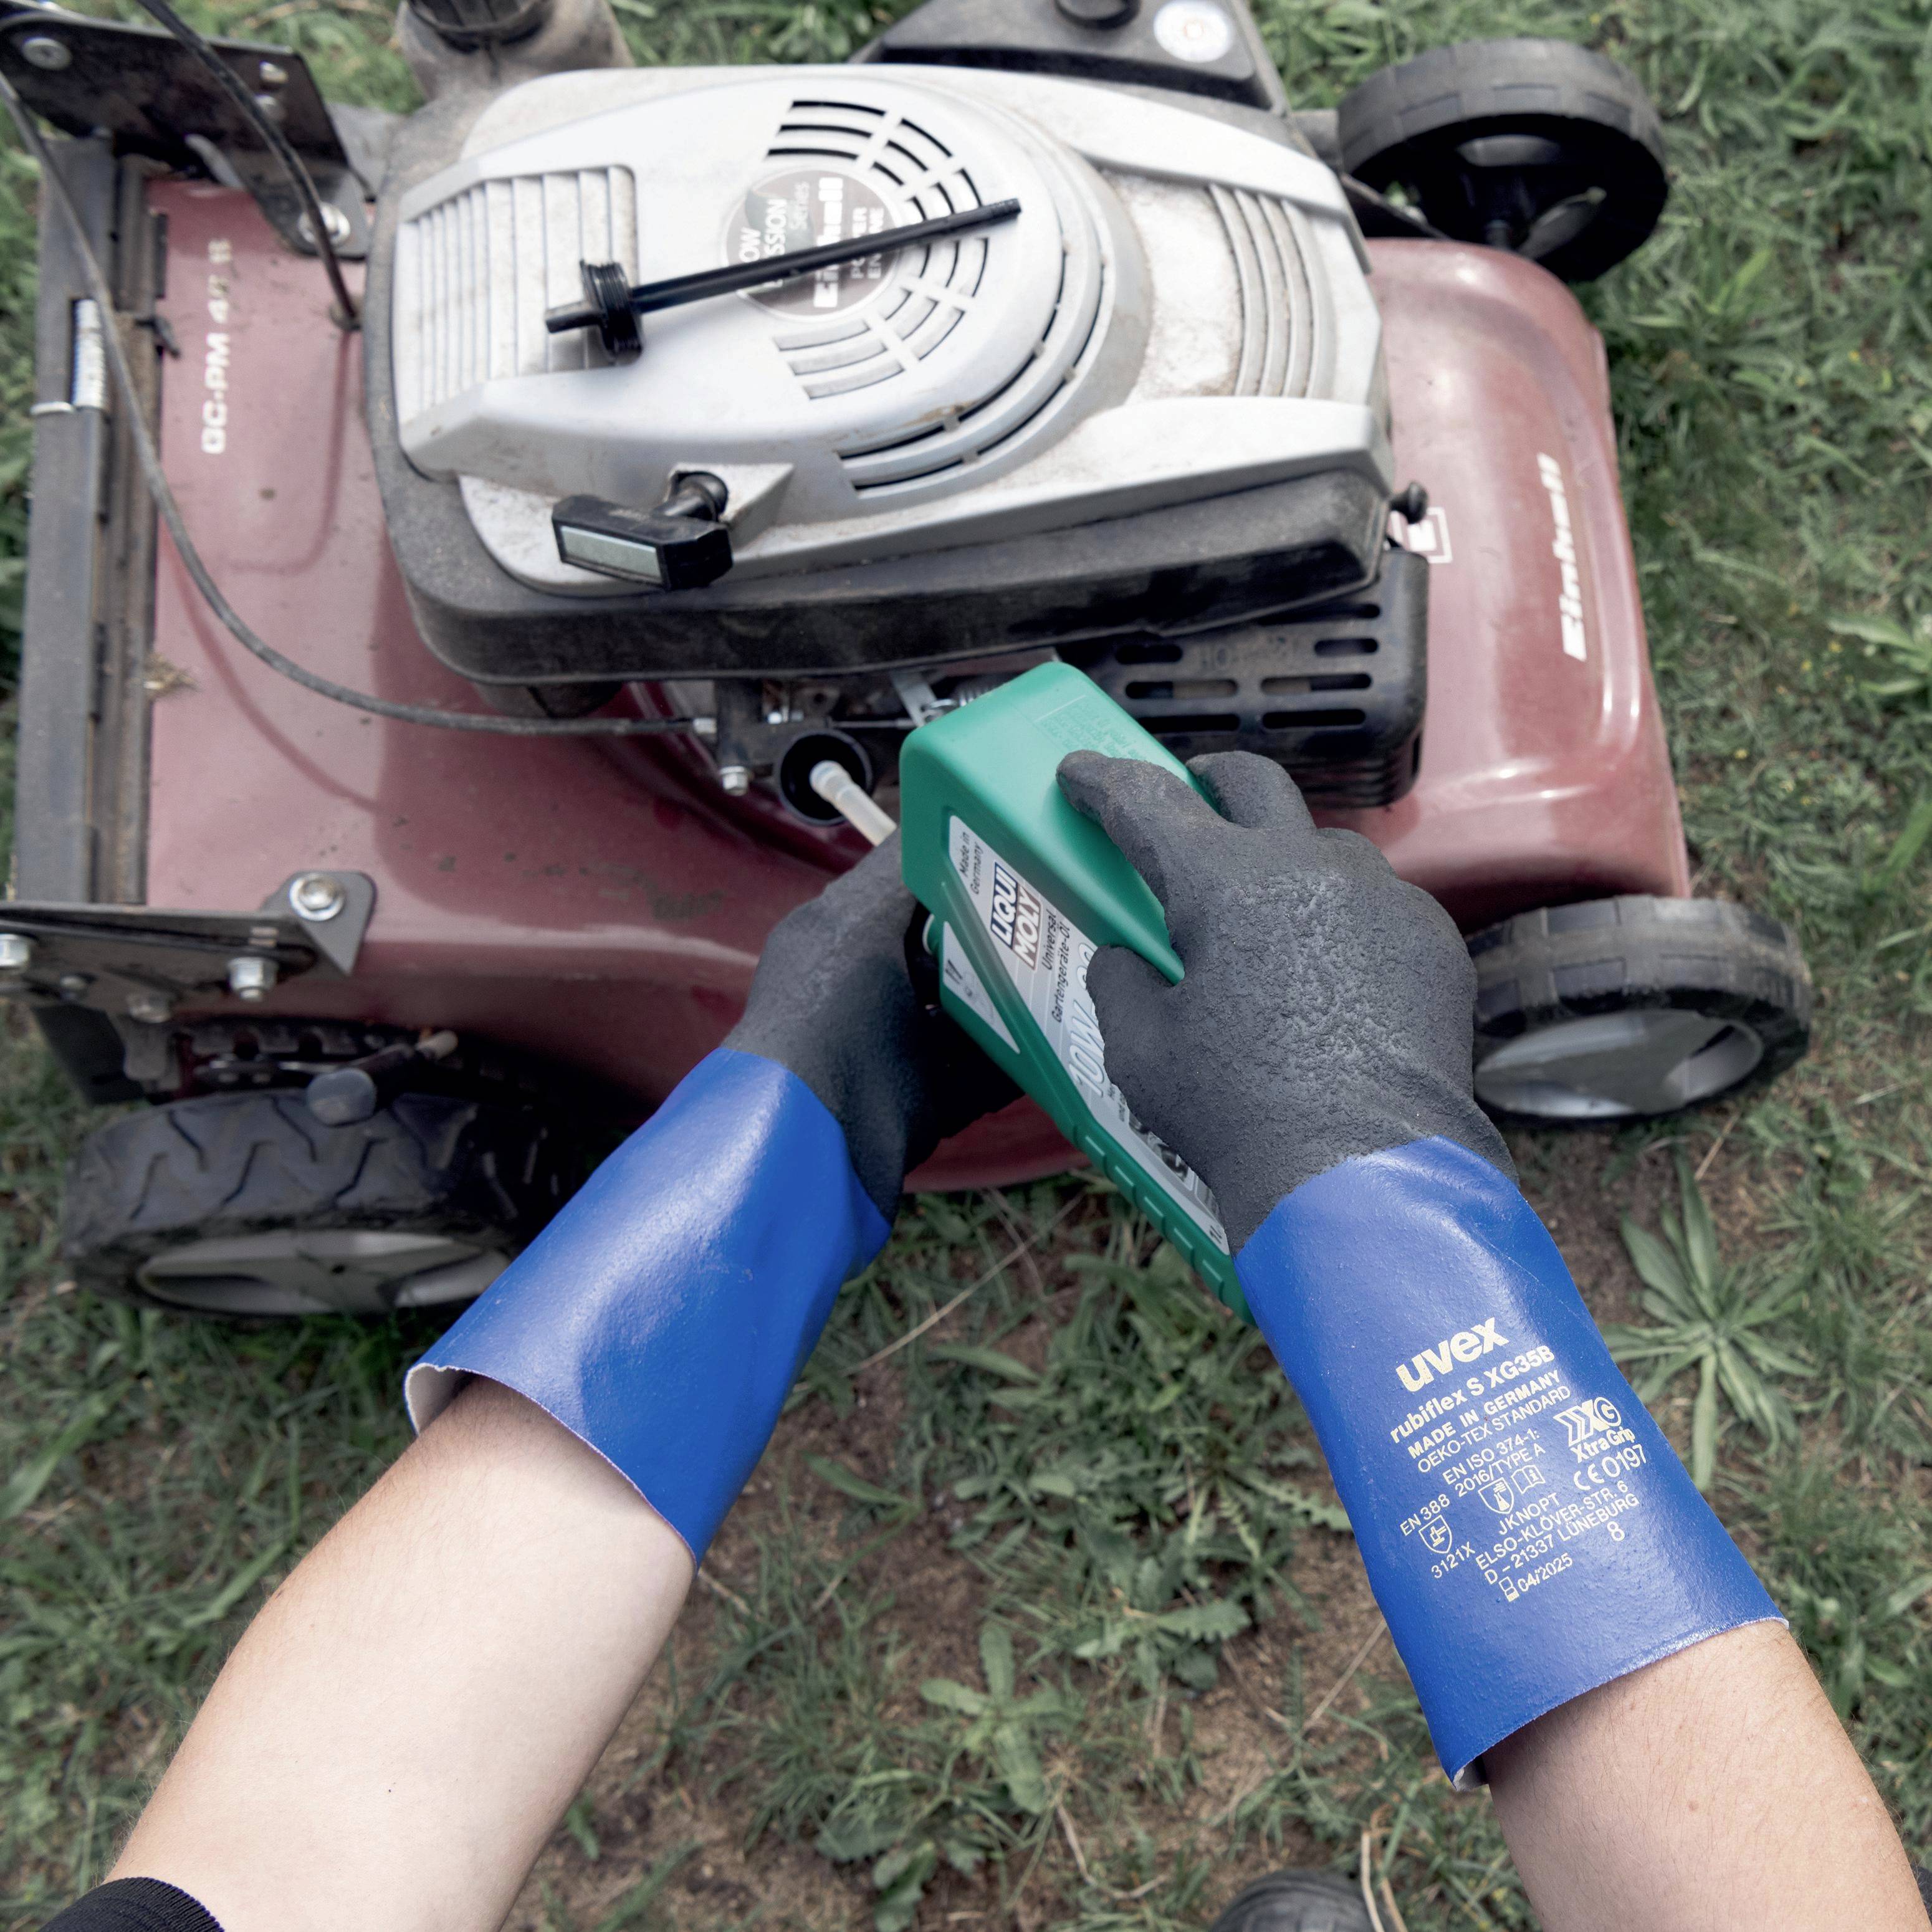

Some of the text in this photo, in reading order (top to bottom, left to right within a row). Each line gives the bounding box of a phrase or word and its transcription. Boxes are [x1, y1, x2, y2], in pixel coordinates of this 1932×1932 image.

[813, 177, 843, 308] Eihell
[960, 843, 970, 878] Made
[970, 841, 984, 895] Germany
[991, 866, 1018, 947] LIQUI
[1013, 886, 1041, 968] MOLY
[1042, 909, 1057, 971] Universal
[1051, 921, 1071, 1023] Gartengeräte-Öl
[1396, 1317, 1509, 1392] uvex
[1390, 1346, 1555, 1443] rubiflex S XG35B
[1408, 1370, 1559, 1459] MADE IN GERMANY
[1418, 1385, 1571, 1473] OEKO-TEX STANDARD
[1442, 1428, 1539, 1485] EN ISO 374-1:
[1602, 1444, 1646, 1478] 0197
[1455, 1443, 1546, 1497] 2016/TYPE A
[1400, 1494, 1450, 1536] EN 388
[1476, 1480, 1628, 1570] ELSO-KLÖVER-STR. 6
[1484, 1569, 1498, 1585] D
[1511, 1534, 1554, 1569] 21337
[1557, 1493, 1640, 1542] LÜNEBURG
[1499, 1492, 1559, 1535] JKNOPT
[1607, 1521, 1625, 1542] 8
[1432, 1541, 1475, 1579] 3121X
